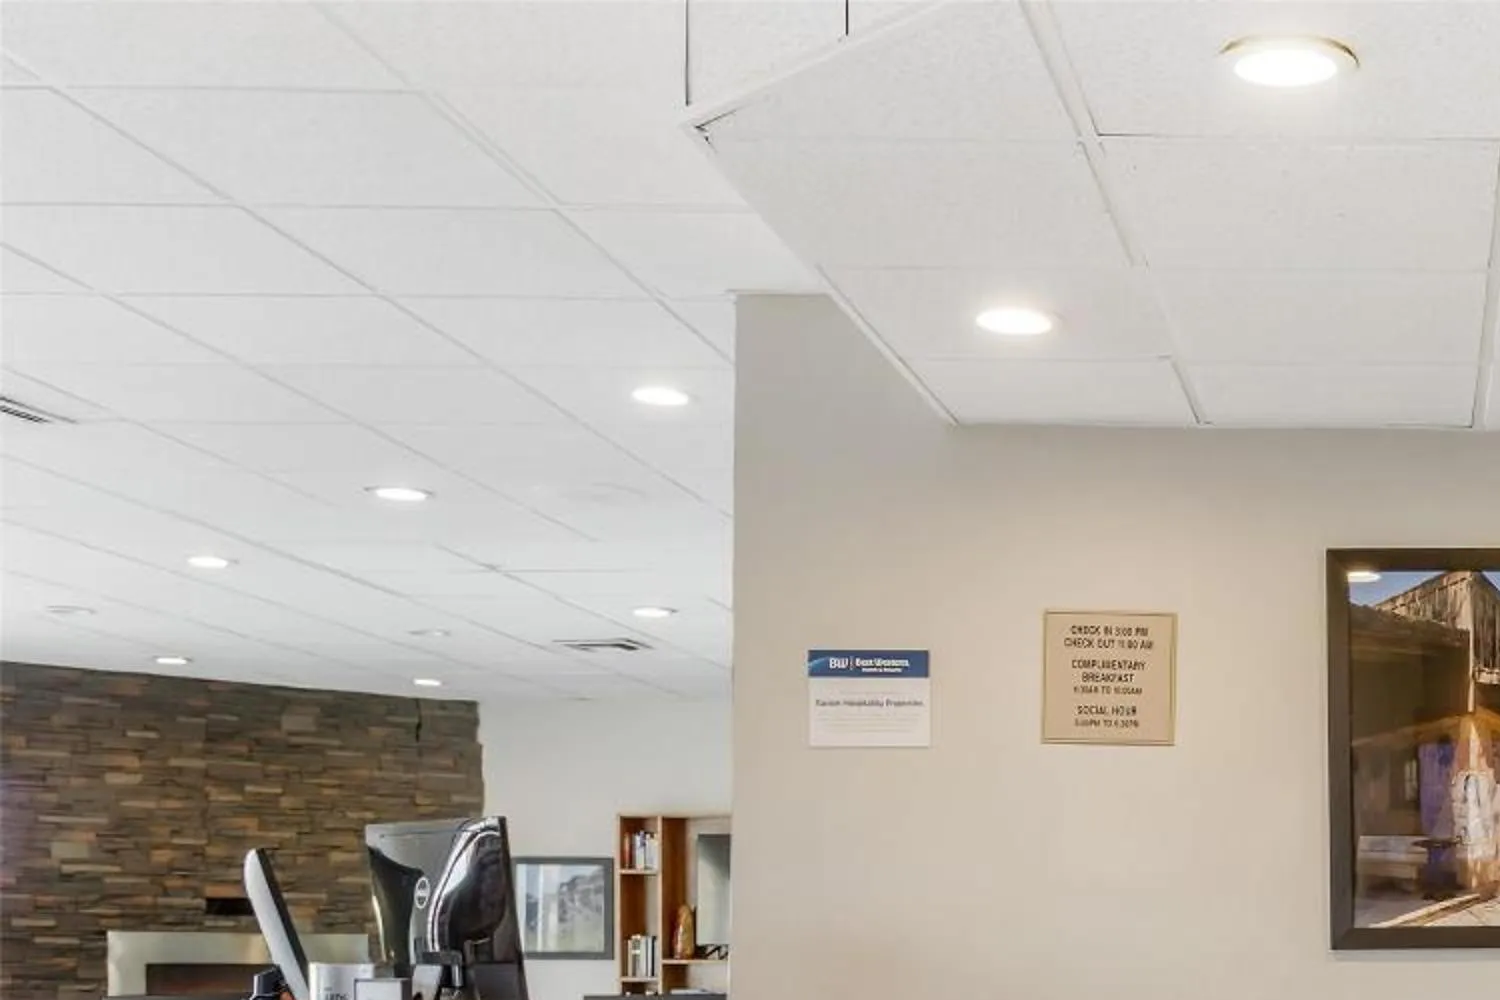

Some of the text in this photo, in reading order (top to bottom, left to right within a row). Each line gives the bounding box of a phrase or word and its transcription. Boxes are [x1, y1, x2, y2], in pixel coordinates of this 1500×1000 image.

[1071, 625, 1101, 635] CHECK
[1104, 626, 1112, 635] IN
[1135, 627, 1148, 636] PM
[1063, 638, 1095, 648] CHECK
[1098, 639, 1115, 648] OUT
[829, 657, 848, 669] BW
[1082, 672, 1134, 682] BREAKFAST
[1112, 706, 1136, 716] HOUR
